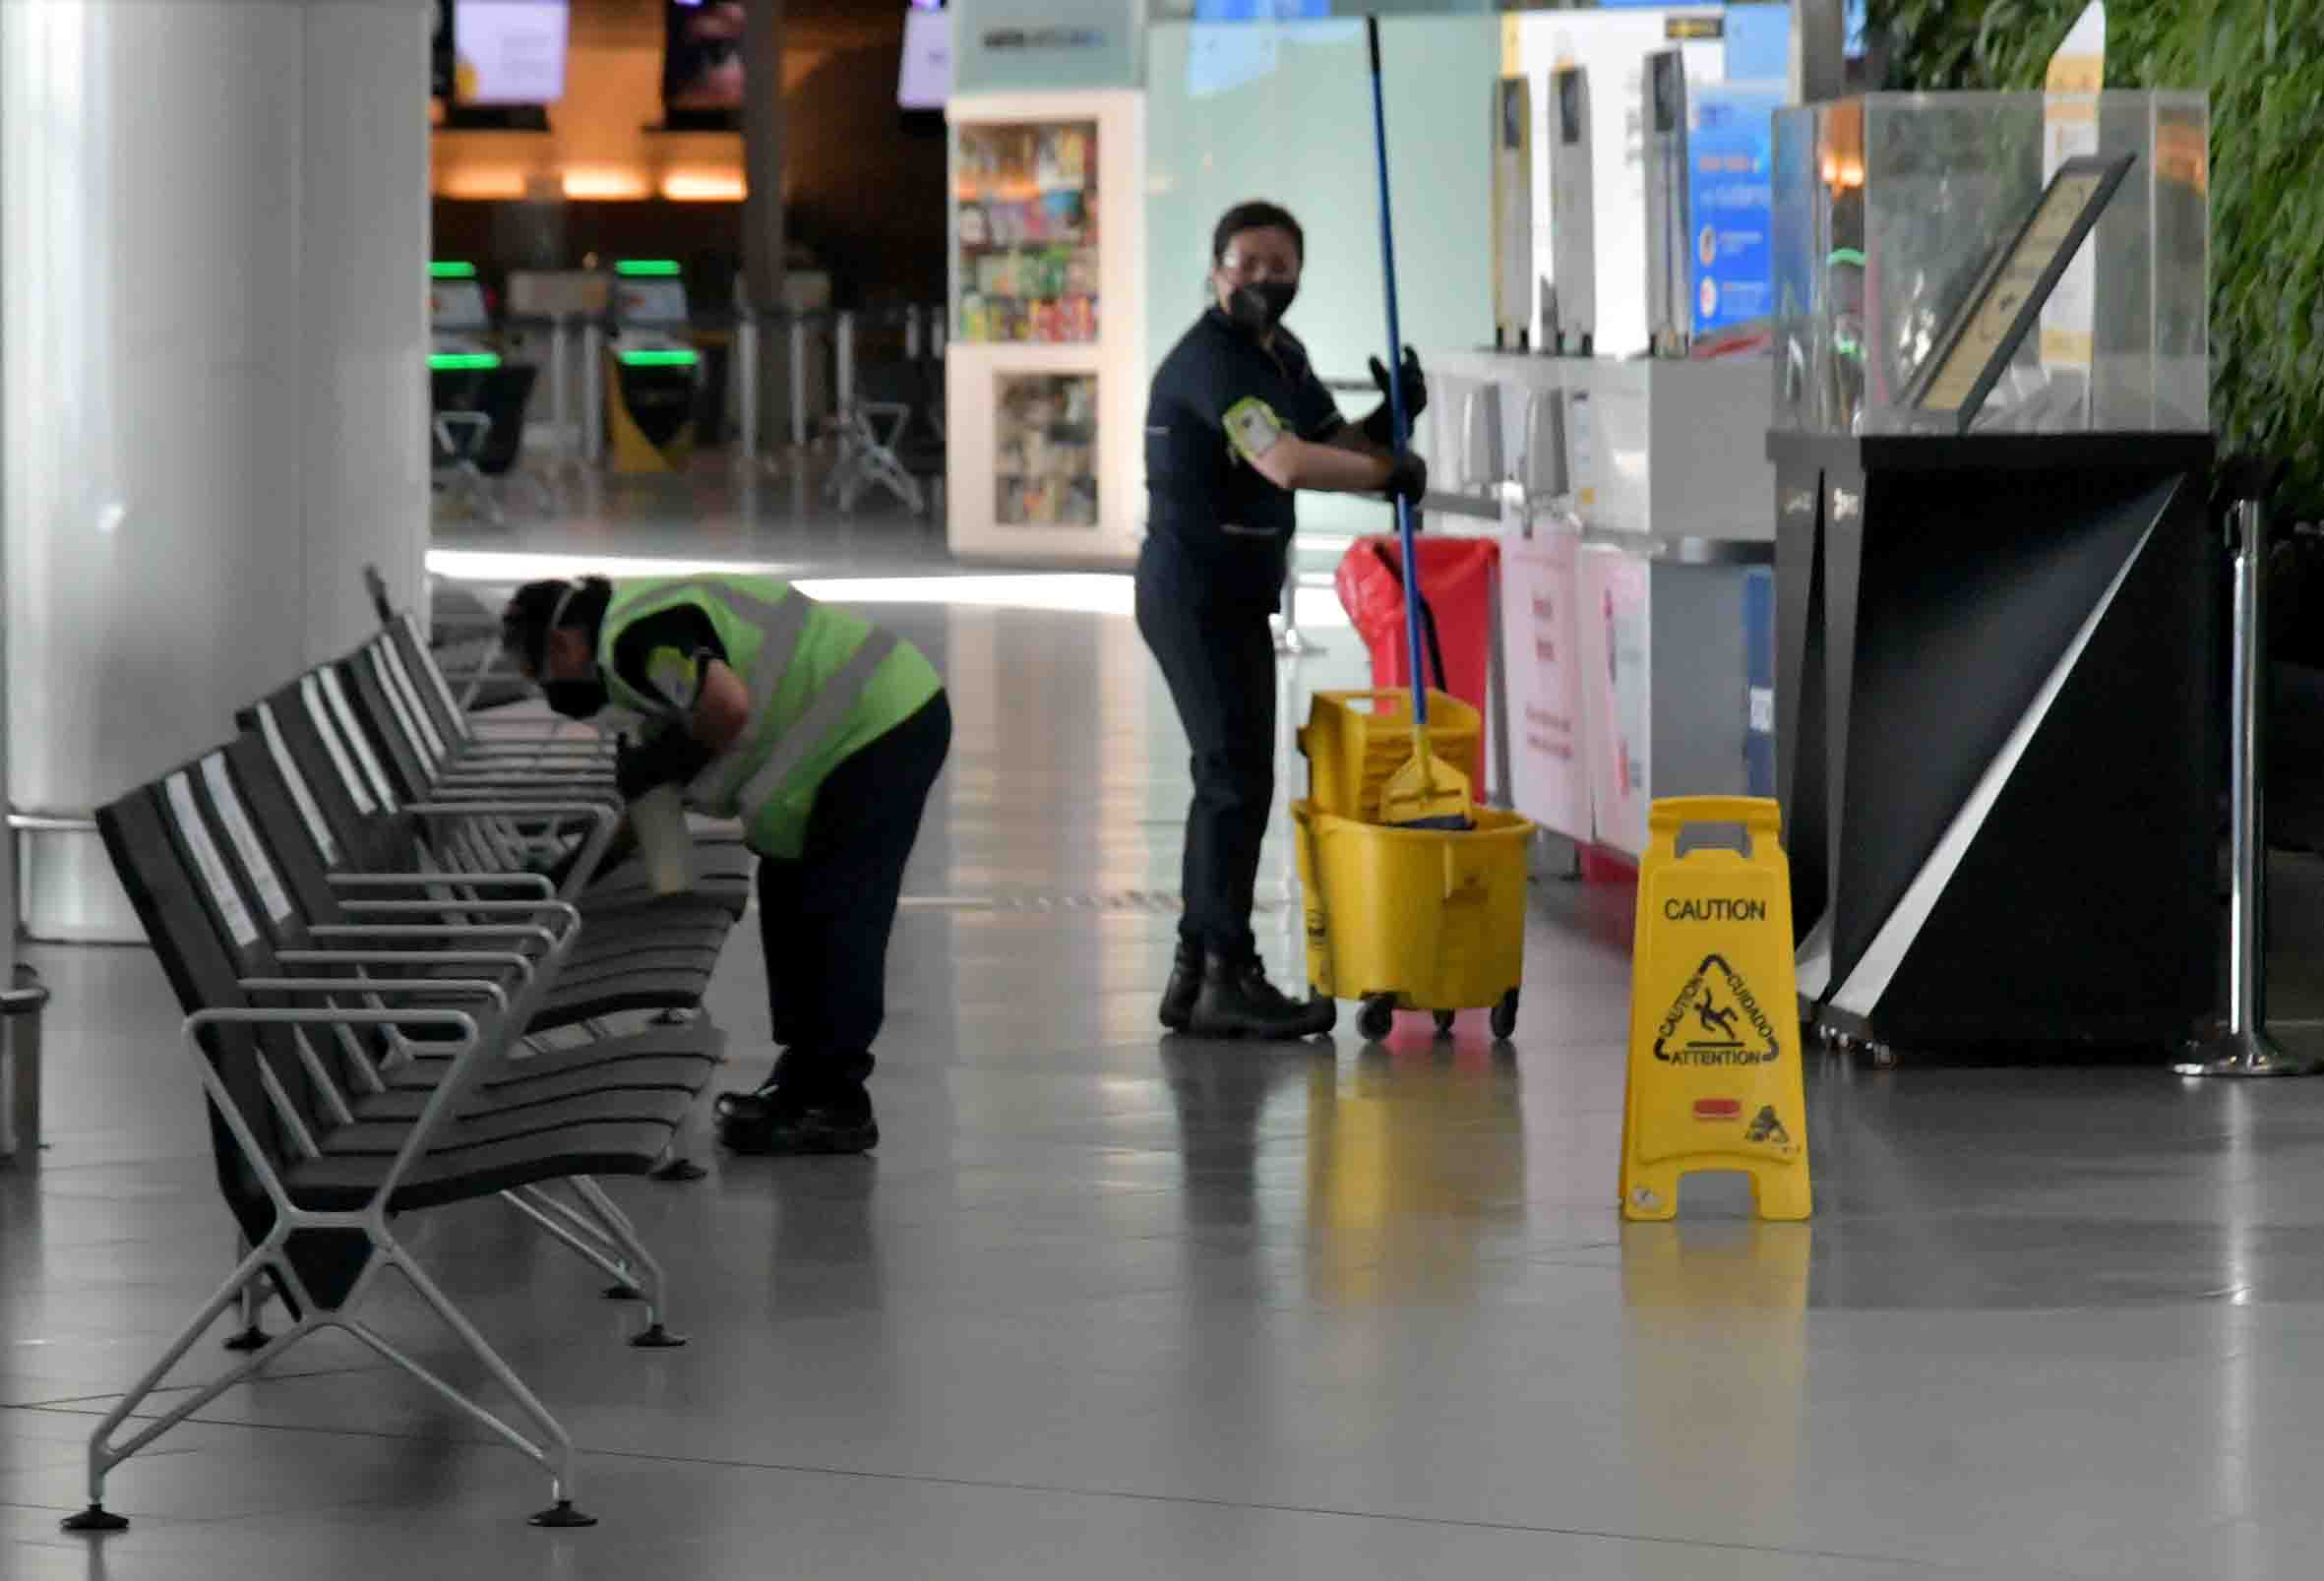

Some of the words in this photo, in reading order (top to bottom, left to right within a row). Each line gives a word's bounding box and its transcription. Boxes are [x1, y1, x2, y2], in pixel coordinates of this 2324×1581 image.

[1665, 898, 1765, 921] CAUTION
[1658, 976, 1702, 1039] CAUTION
[1727, 975, 1773, 1039] CUIDADO
[1670, 1050, 1761, 1065] ATTENTION
